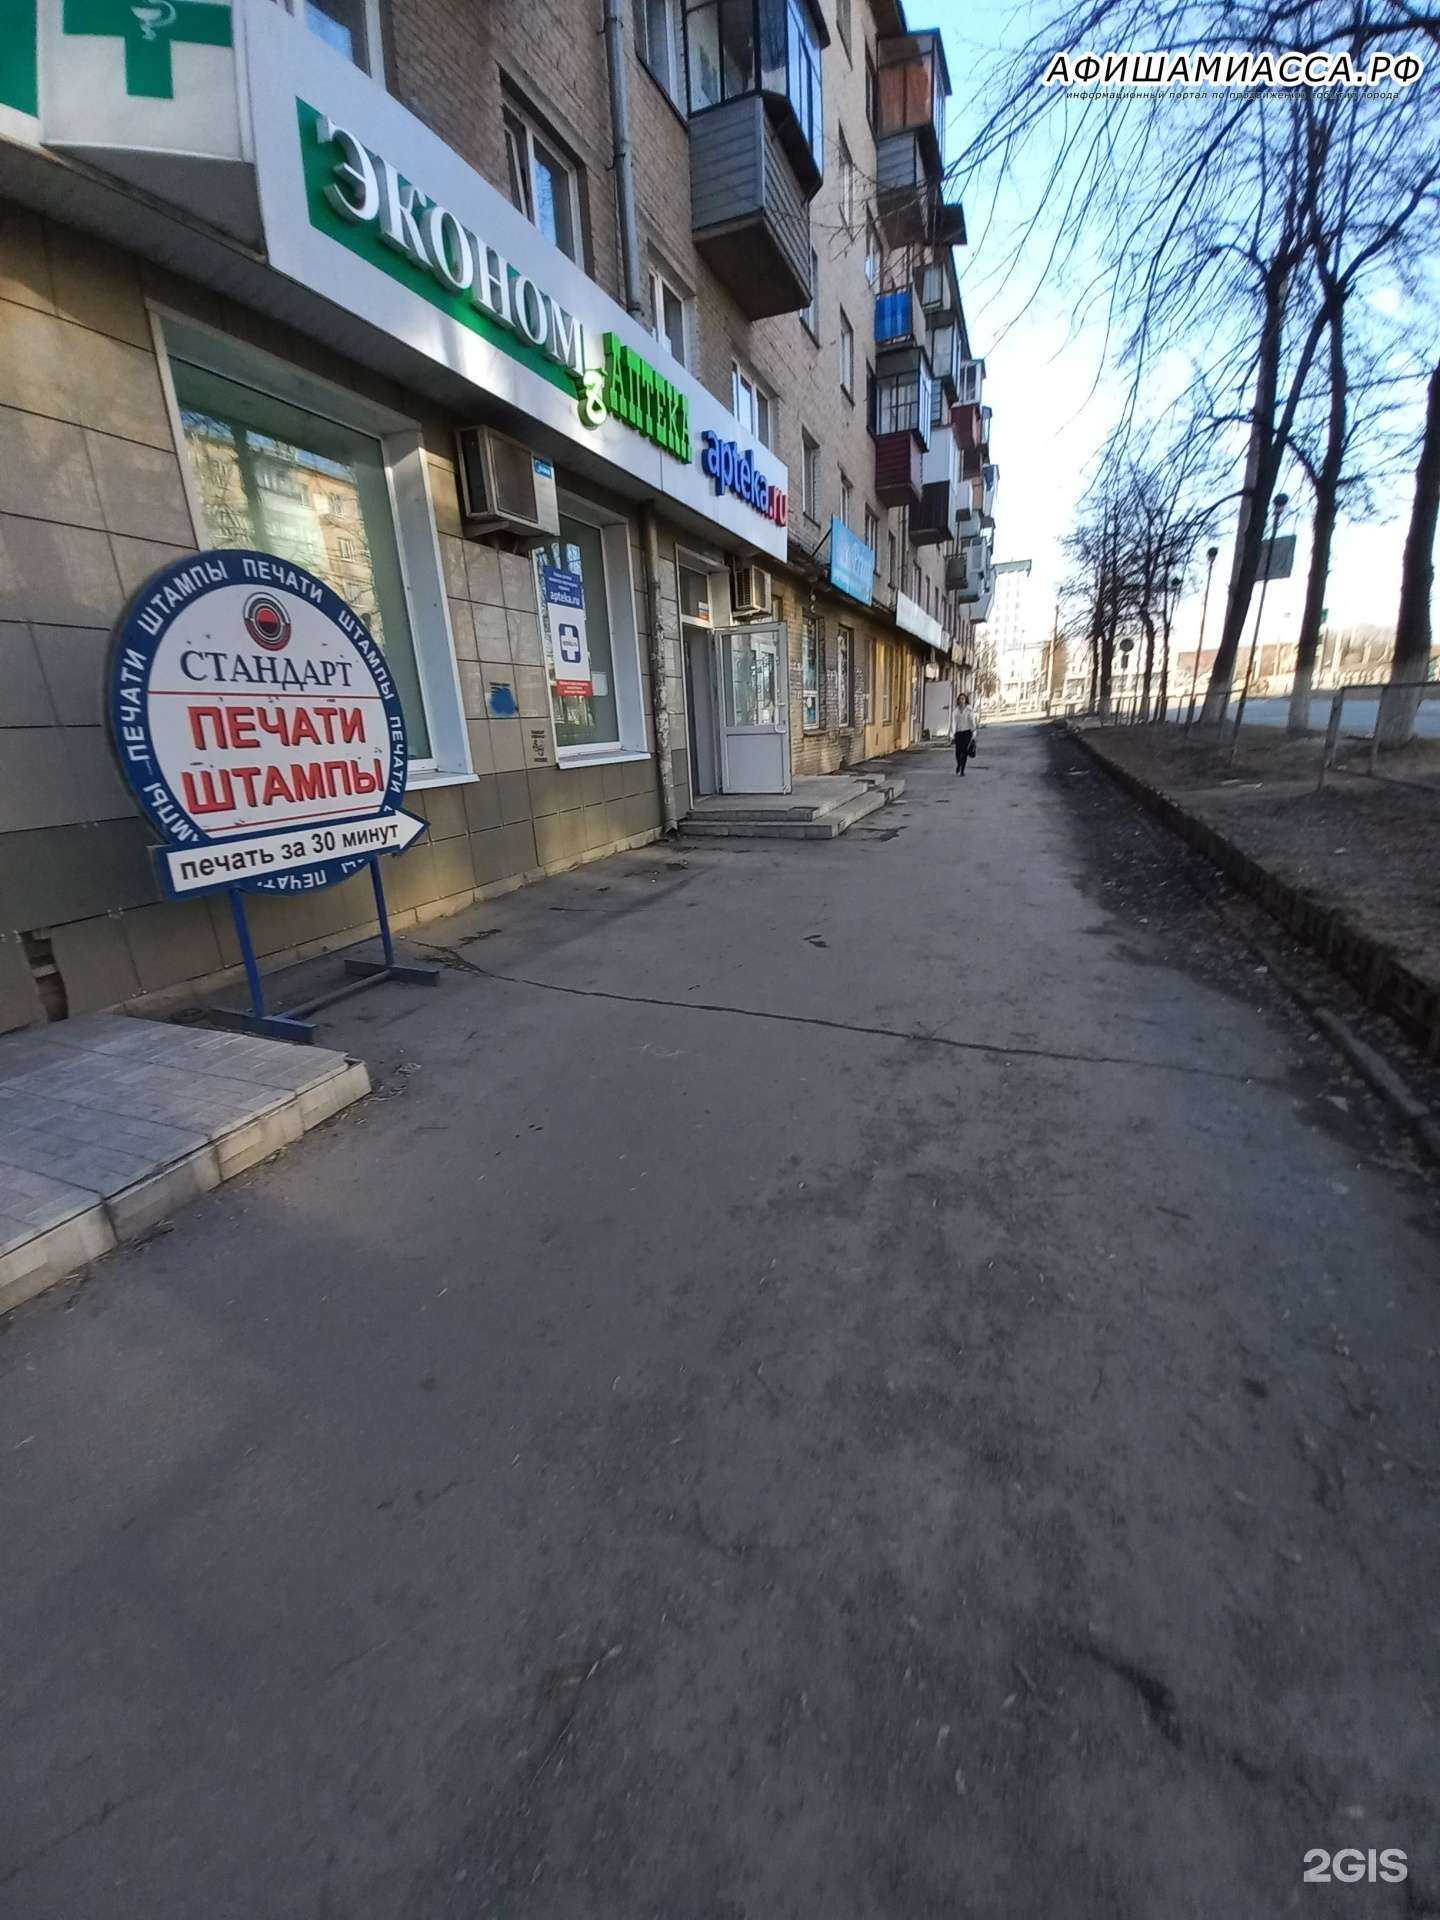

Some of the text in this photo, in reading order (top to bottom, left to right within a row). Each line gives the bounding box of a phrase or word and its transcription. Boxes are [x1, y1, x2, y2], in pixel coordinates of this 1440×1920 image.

[315, 115, 585, 378] ЭКОНОМ
[603, 331, 692, 464] АПТЕКА
[701, 430, 788, 527] apteka.ru
[122, 649, 148, 762] ПЕЧАТИ
[138, 559, 229, 636] ШТАМПЫ
[242, 558, 323, 603] ПЕЧАТИ
[338, 610, 394, 700] ШТАМПЫ
[389, 716, 404, 793] ПЕЧАТИ
[180, 650, 352, 691] СТАНДАРТ
[187, 706, 366, 750] ПЕЧАТИ
[180, 758, 384, 815] ШТАМПЫ
[180, 822, 398, 880] печать за 30 минут
